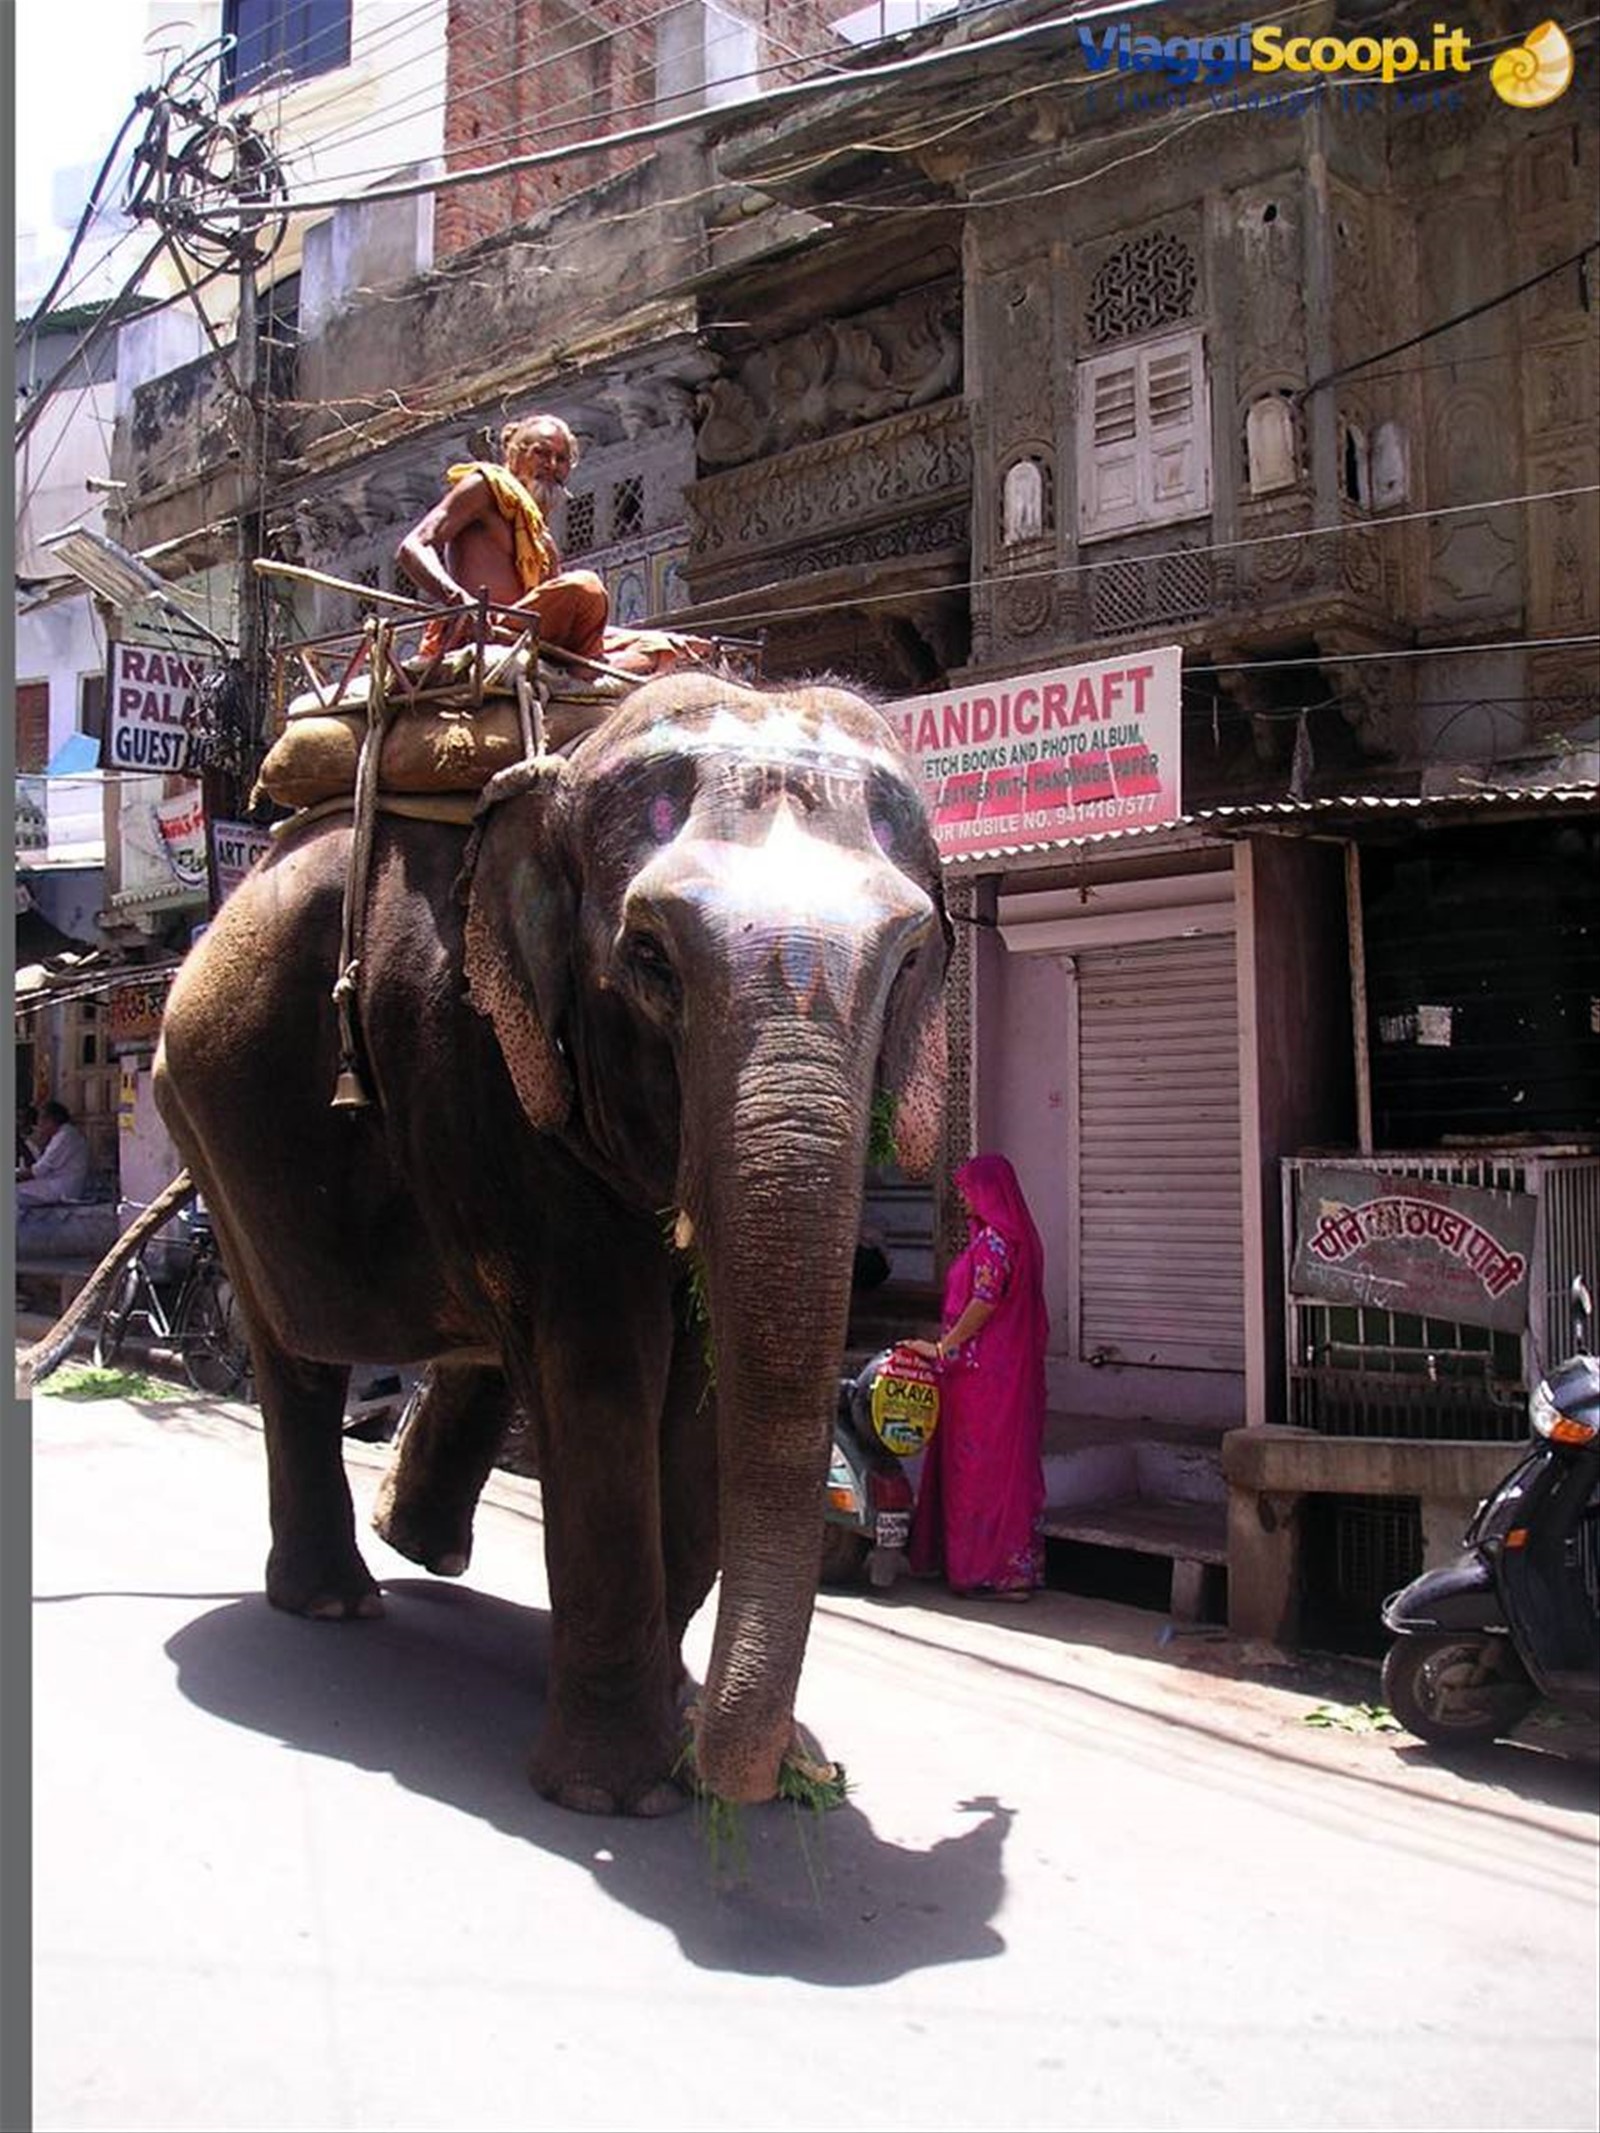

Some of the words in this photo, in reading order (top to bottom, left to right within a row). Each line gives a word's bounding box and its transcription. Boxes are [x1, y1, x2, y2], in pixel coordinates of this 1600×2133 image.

[116, 727, 185, 768] GUEST
[924, 755, 959, 779] ETCH
[962, 746, 1006, 771] BOOKS
[1009, 739, 1037, 763] AND
[1041, 731, 1085, 758] PHOTO
[959, 814, 1019, 839] MOBILE
[1023, 810, 1052, 829] NO.
[219, 840, 246, 867] ART
[885, 1379, 934, 1405] OKAYA
